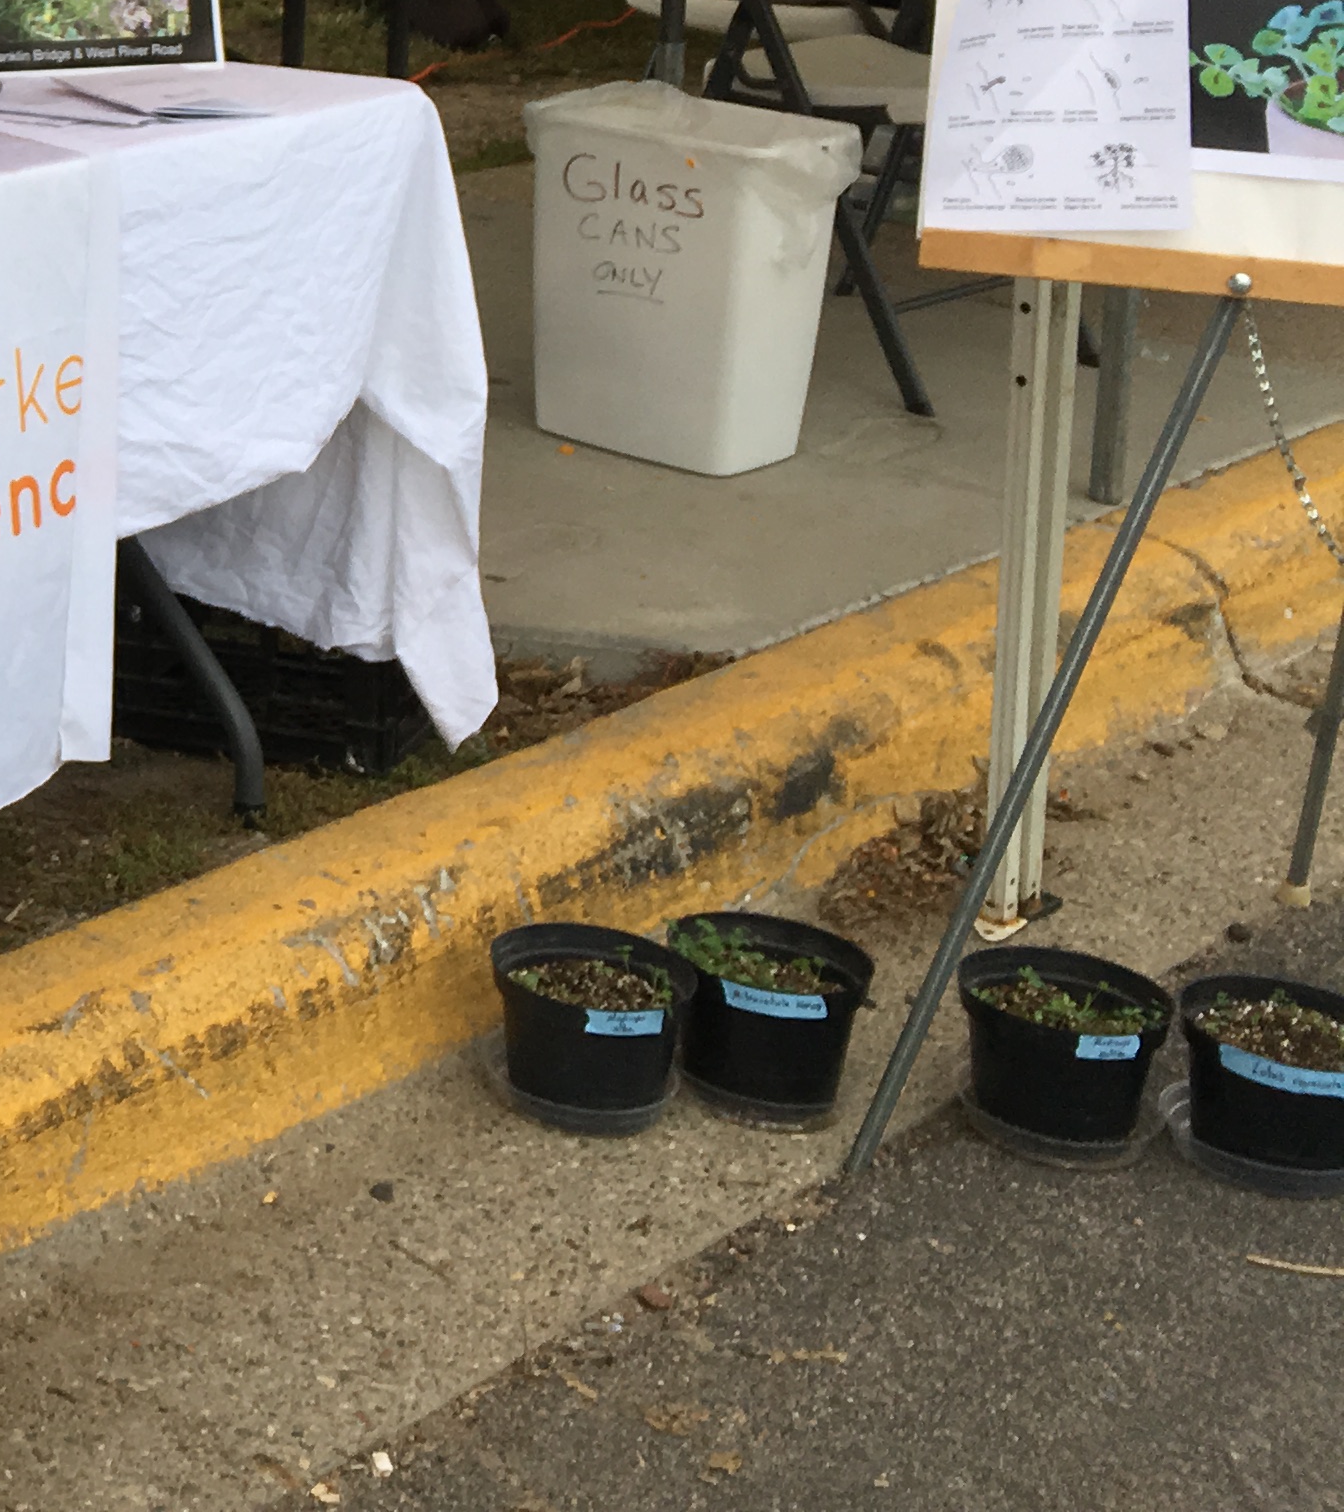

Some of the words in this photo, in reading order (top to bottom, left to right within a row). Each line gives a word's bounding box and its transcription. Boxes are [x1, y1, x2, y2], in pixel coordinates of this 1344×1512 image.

[33, 49, 71, 63] Bridge
[151, 44, 182, 56] Road
[563, 152, 705, 219] Glass
[577, 212, 683, 254] CANS
[592, 259, 663, 296] ONLY
